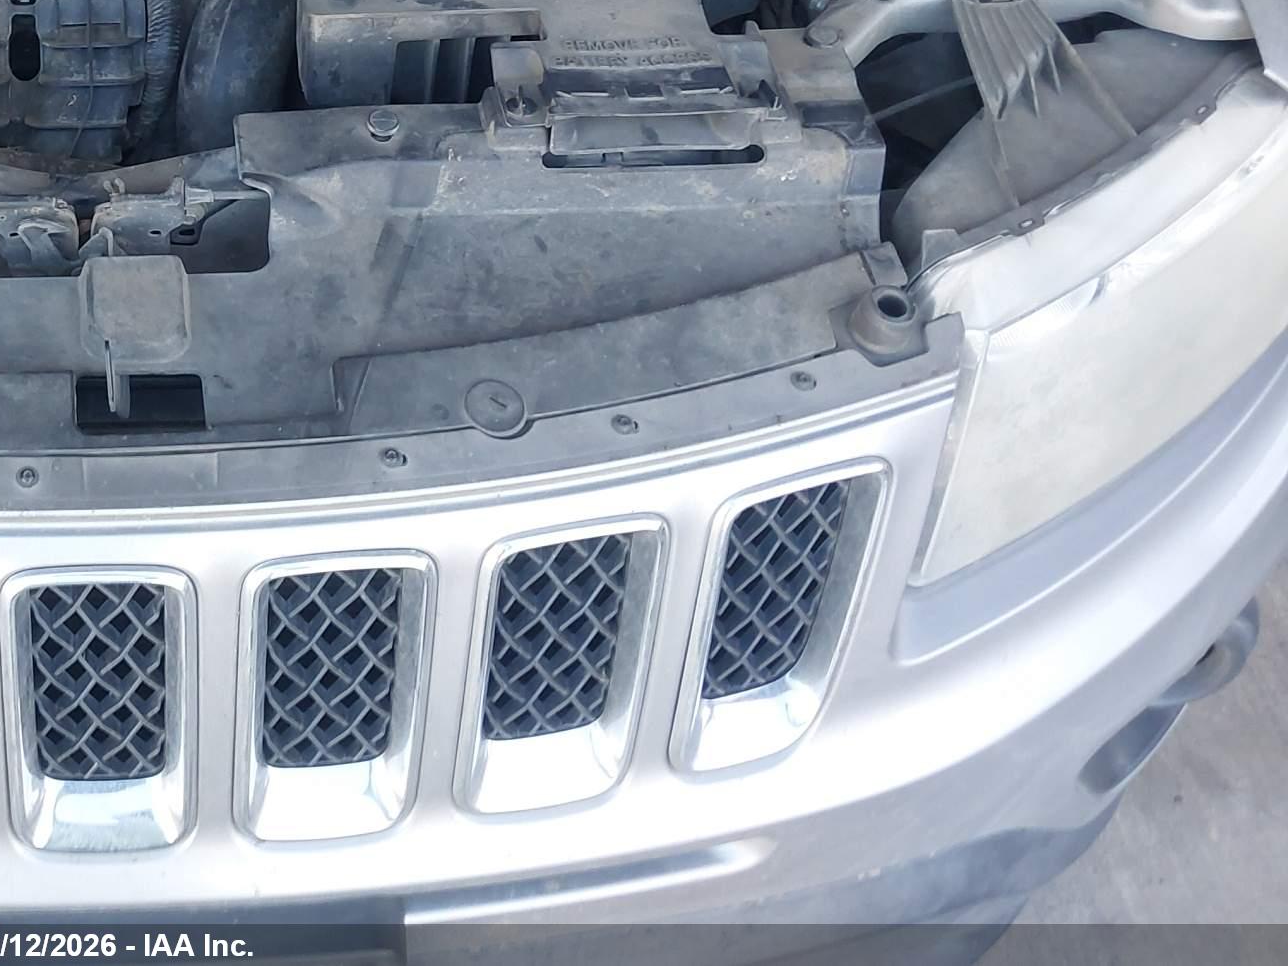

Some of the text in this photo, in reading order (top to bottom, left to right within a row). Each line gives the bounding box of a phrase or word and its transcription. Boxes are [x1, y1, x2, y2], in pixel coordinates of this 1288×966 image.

[562, 36, 683, 52] REMOVE FOR
[552, 54, 628, 68] BATTERY
